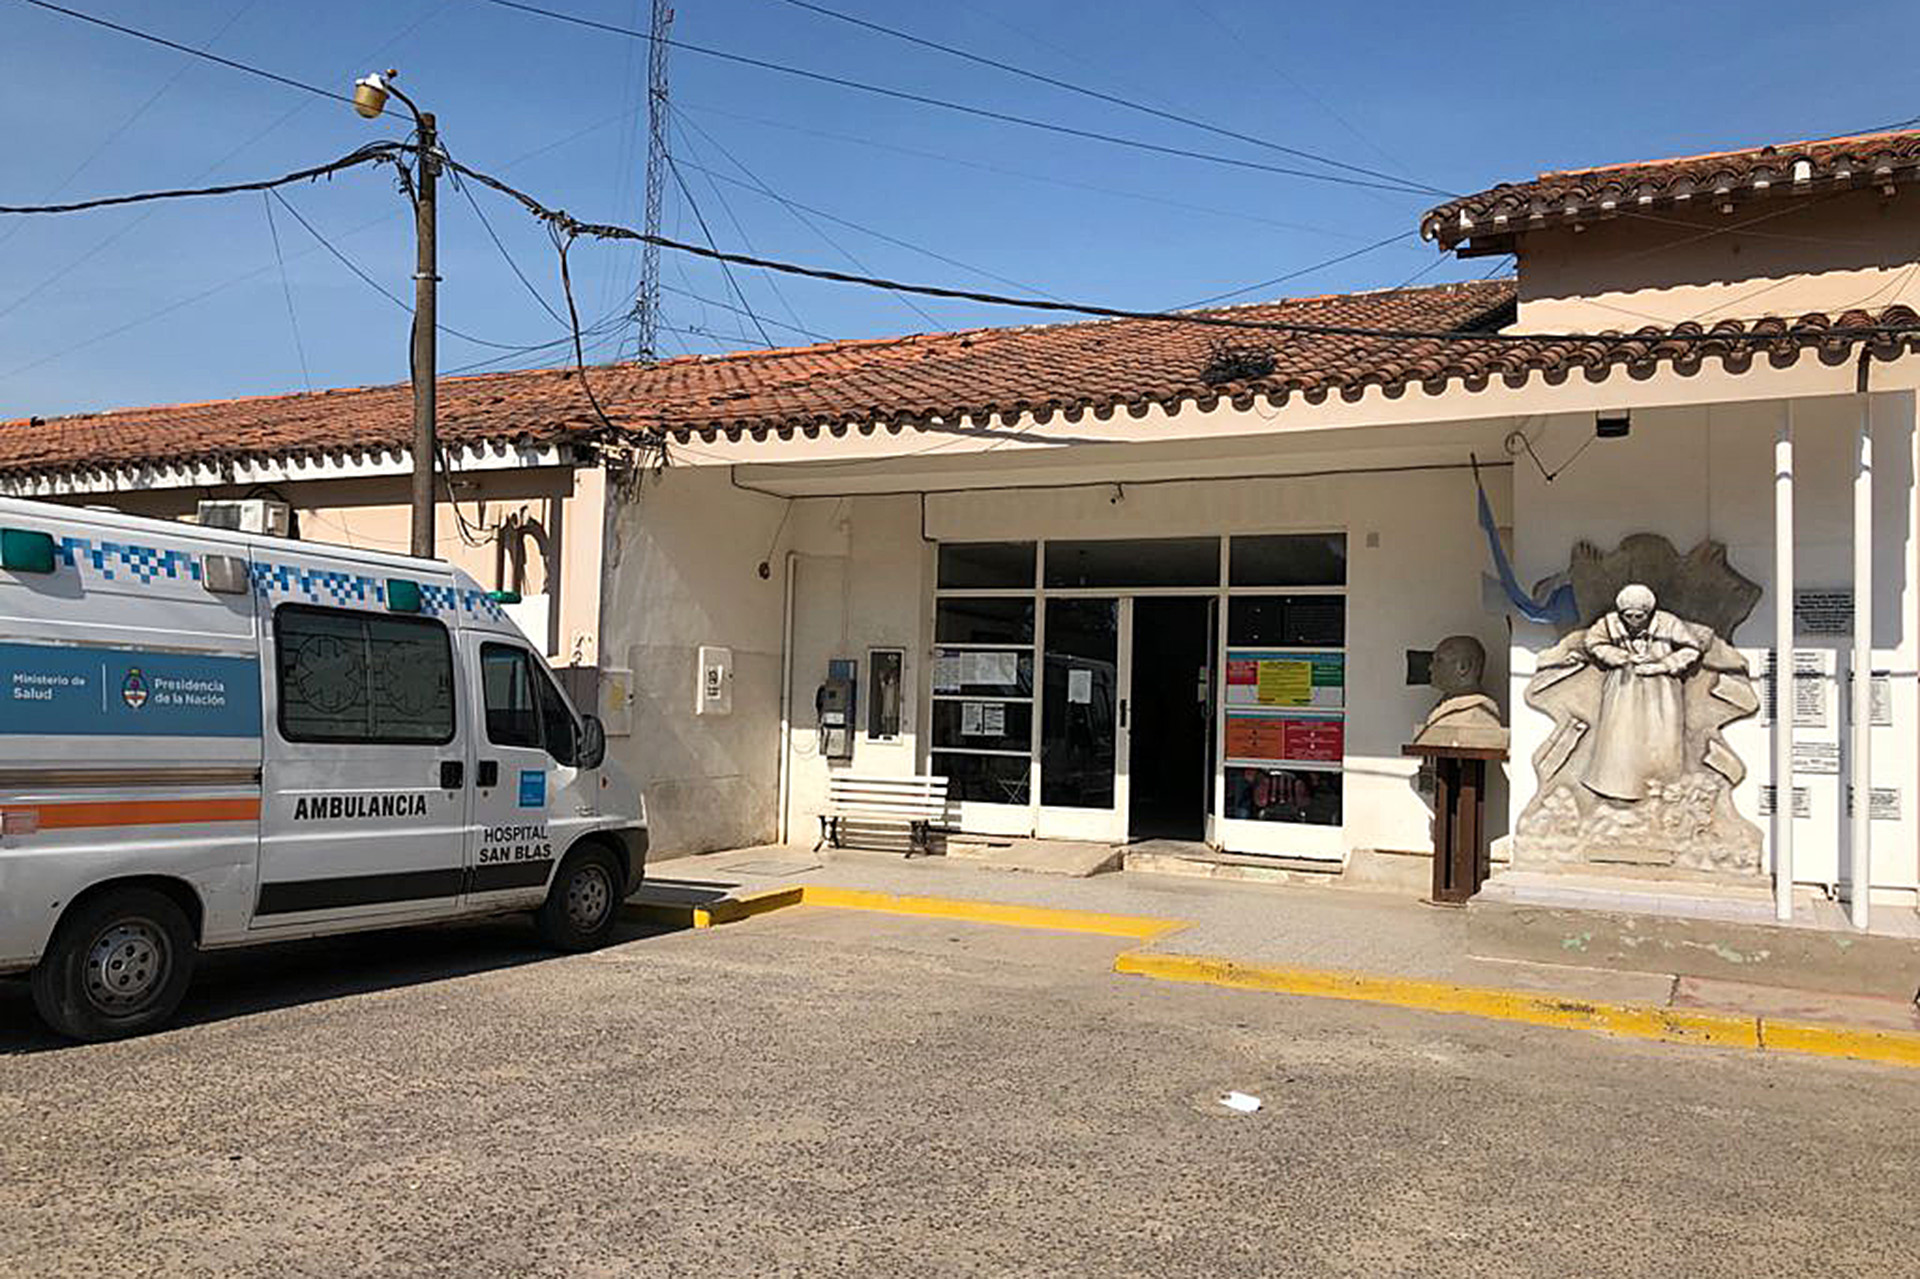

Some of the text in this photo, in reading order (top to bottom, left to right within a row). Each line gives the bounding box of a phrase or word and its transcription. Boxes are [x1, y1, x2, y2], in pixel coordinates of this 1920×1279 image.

[13, 673, 86, 686] Ministerio de
[154, 678, 225, 693] Presidencia
[14, 687, 53, 700] Salud
[154, 692, 226, 706] de la Nación
[294, 795, 427, 820] AMBULANCIA
[484, 826, 548, 842] HOSPITAL
[480, 843, 551, 862] SAN BLAS
